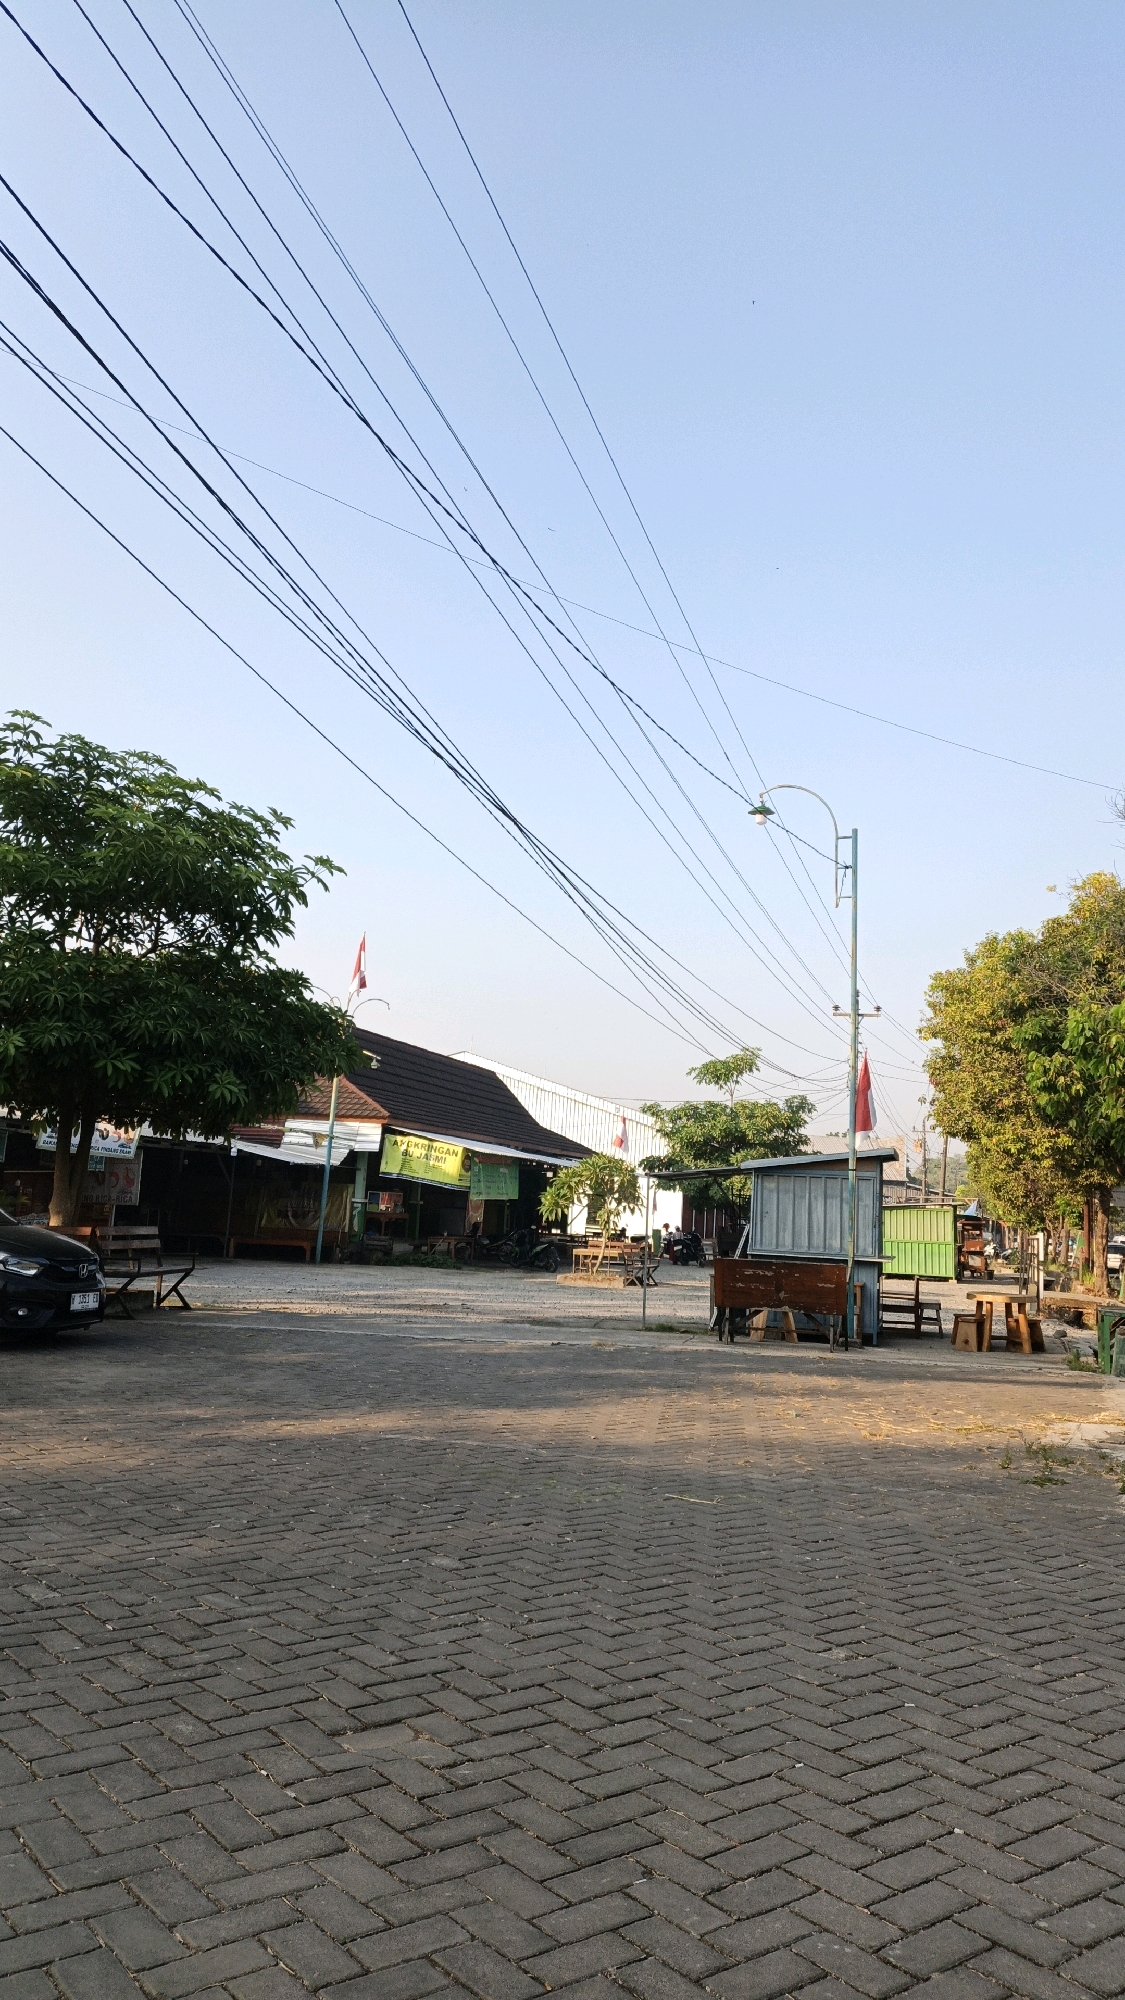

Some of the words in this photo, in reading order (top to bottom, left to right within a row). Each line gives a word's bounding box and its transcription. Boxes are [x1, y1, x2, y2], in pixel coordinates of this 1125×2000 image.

[392, 1139, 459, 1158] ANGKRINGAN
[401, 1148, 414, 1158] BU
[416, 1151, 447, 1165] JASMI
